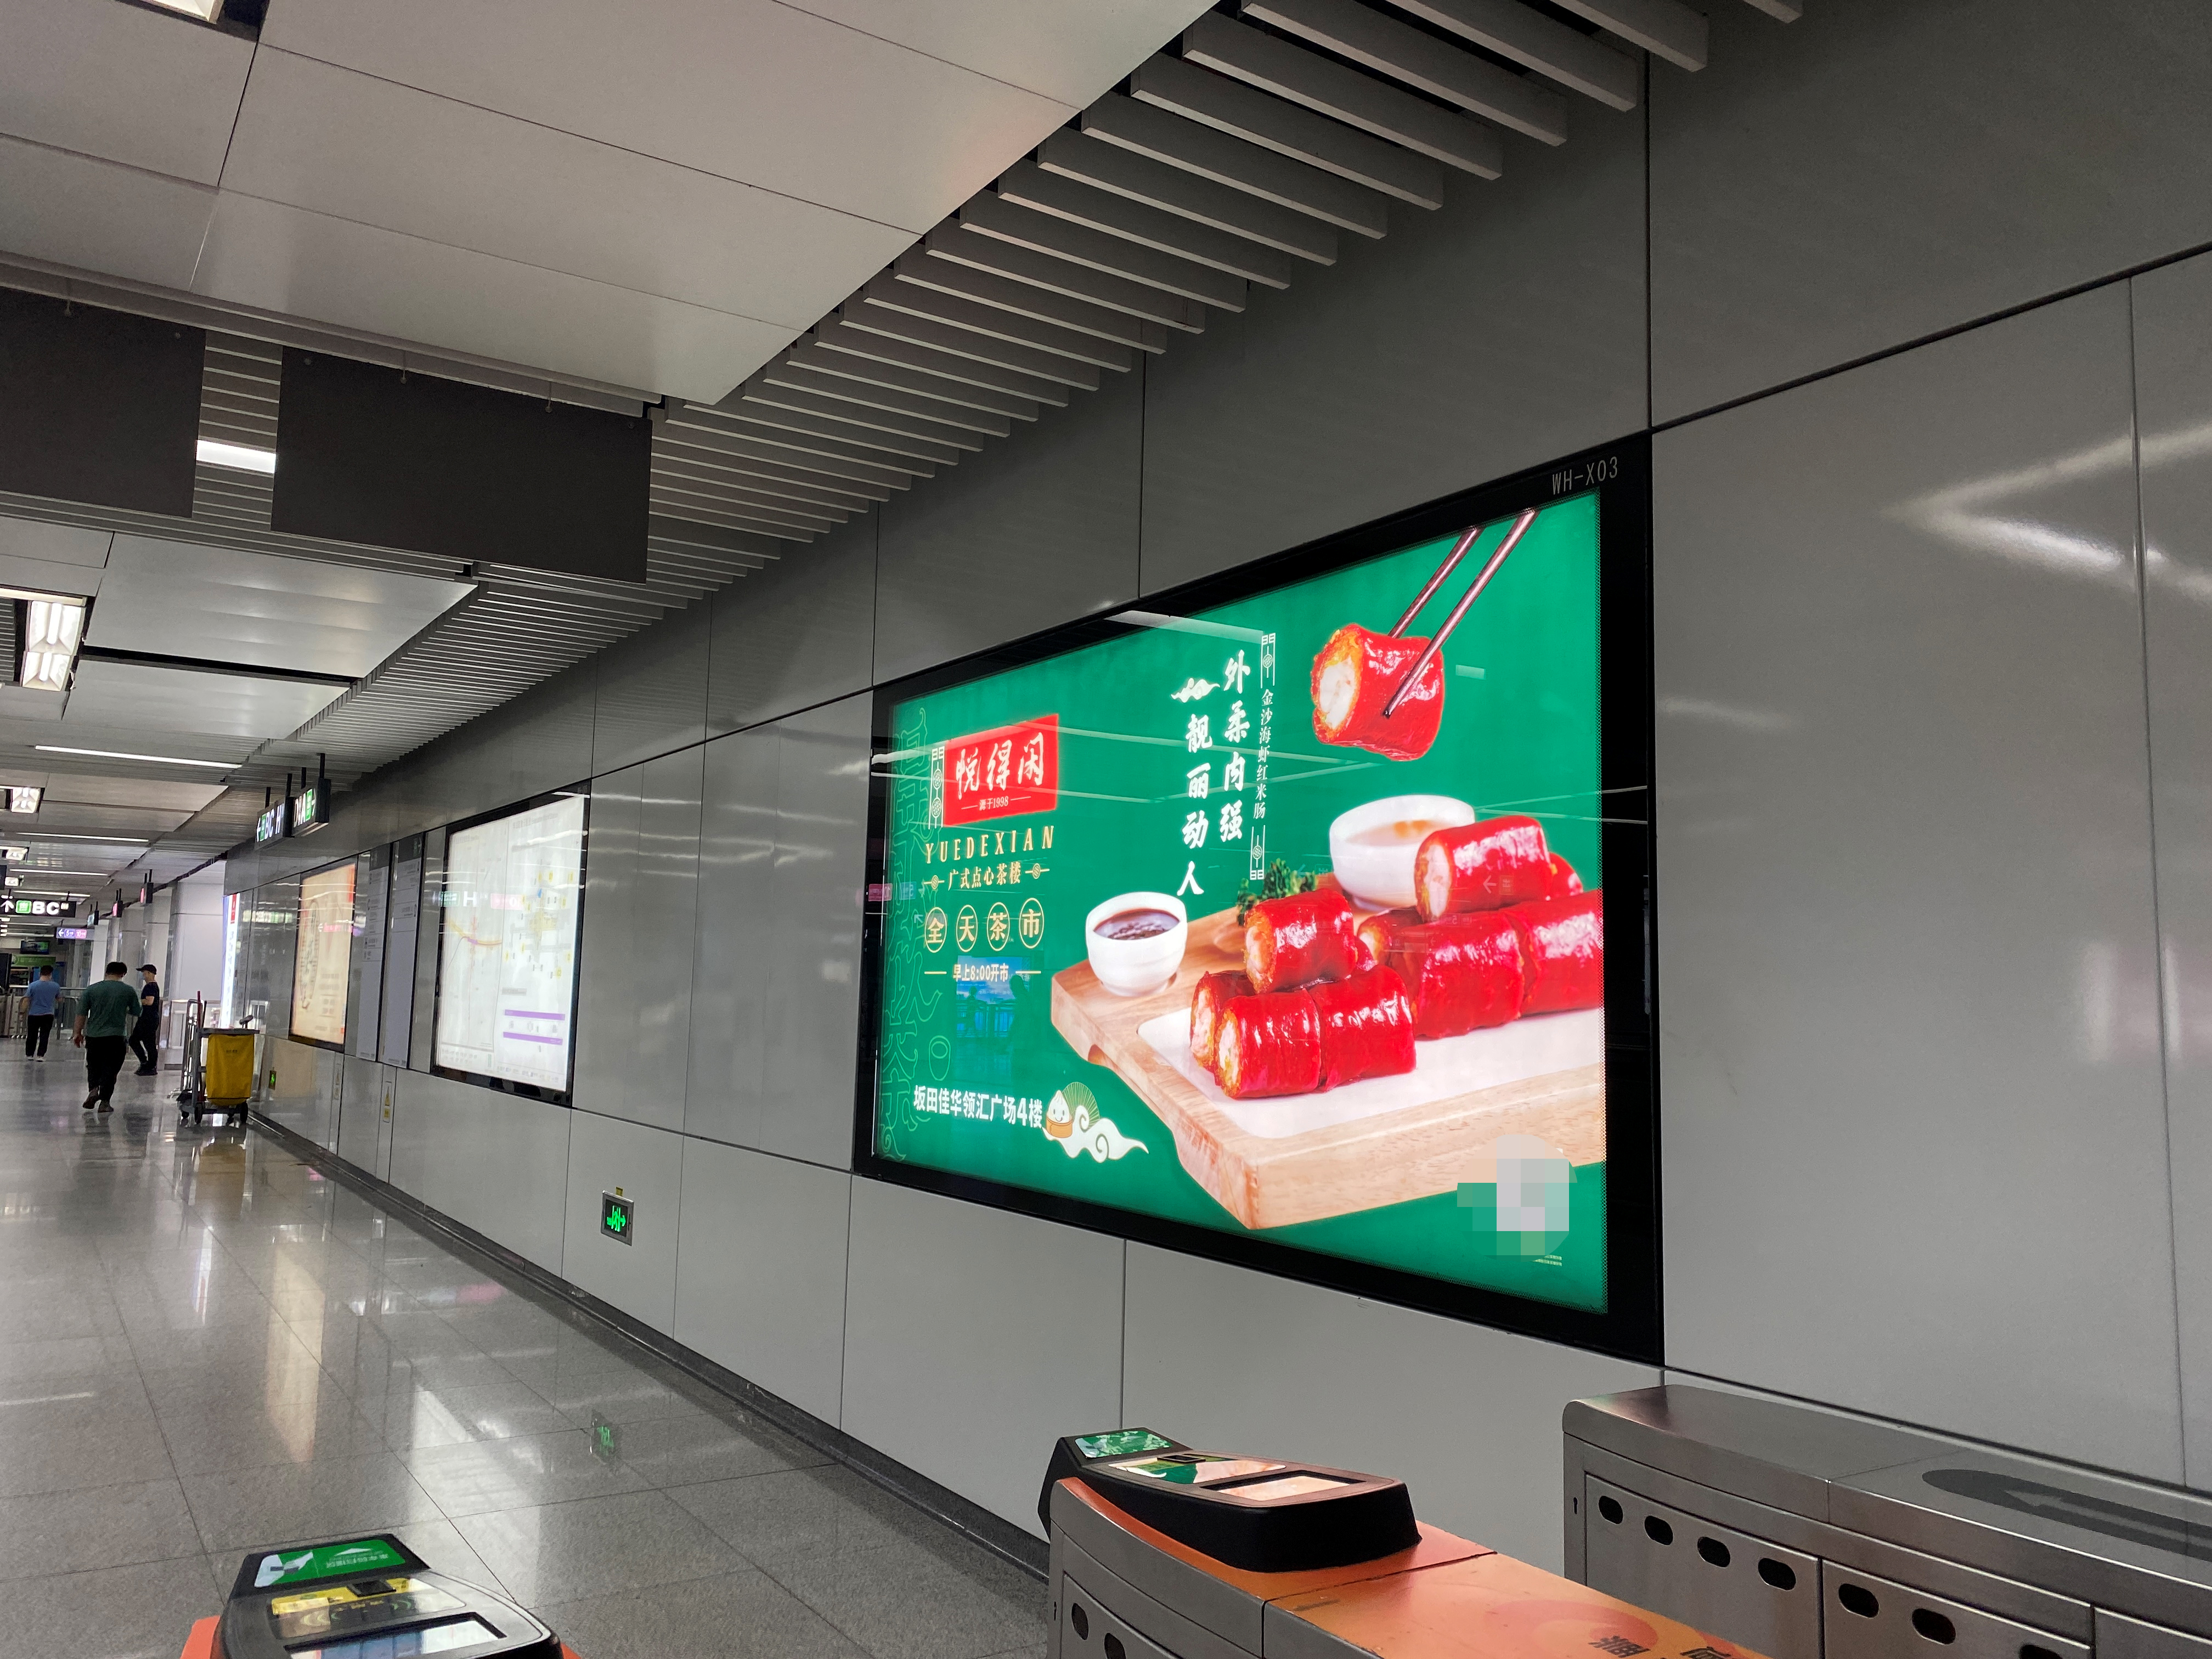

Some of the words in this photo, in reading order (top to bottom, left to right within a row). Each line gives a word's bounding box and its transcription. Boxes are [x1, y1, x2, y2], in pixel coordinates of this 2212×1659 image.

[1552, 456, 1618, 495] WH-X03
[1253, 689, 1274, 820] 金沙海虾红米肠
[1177, 713, 1214, 896] 靓丽动人
[925, 825, 1054, 864] YUEDEXIAN
[947, 861, 1022, 891] 广式点心茶楼
[927, 907, 1042, 945] 全天茶市
[952, 963, 1009, 983] 早上8:00开市
[913, 1085, 1042, 1129] 坂田佳华领汇广场4楼
